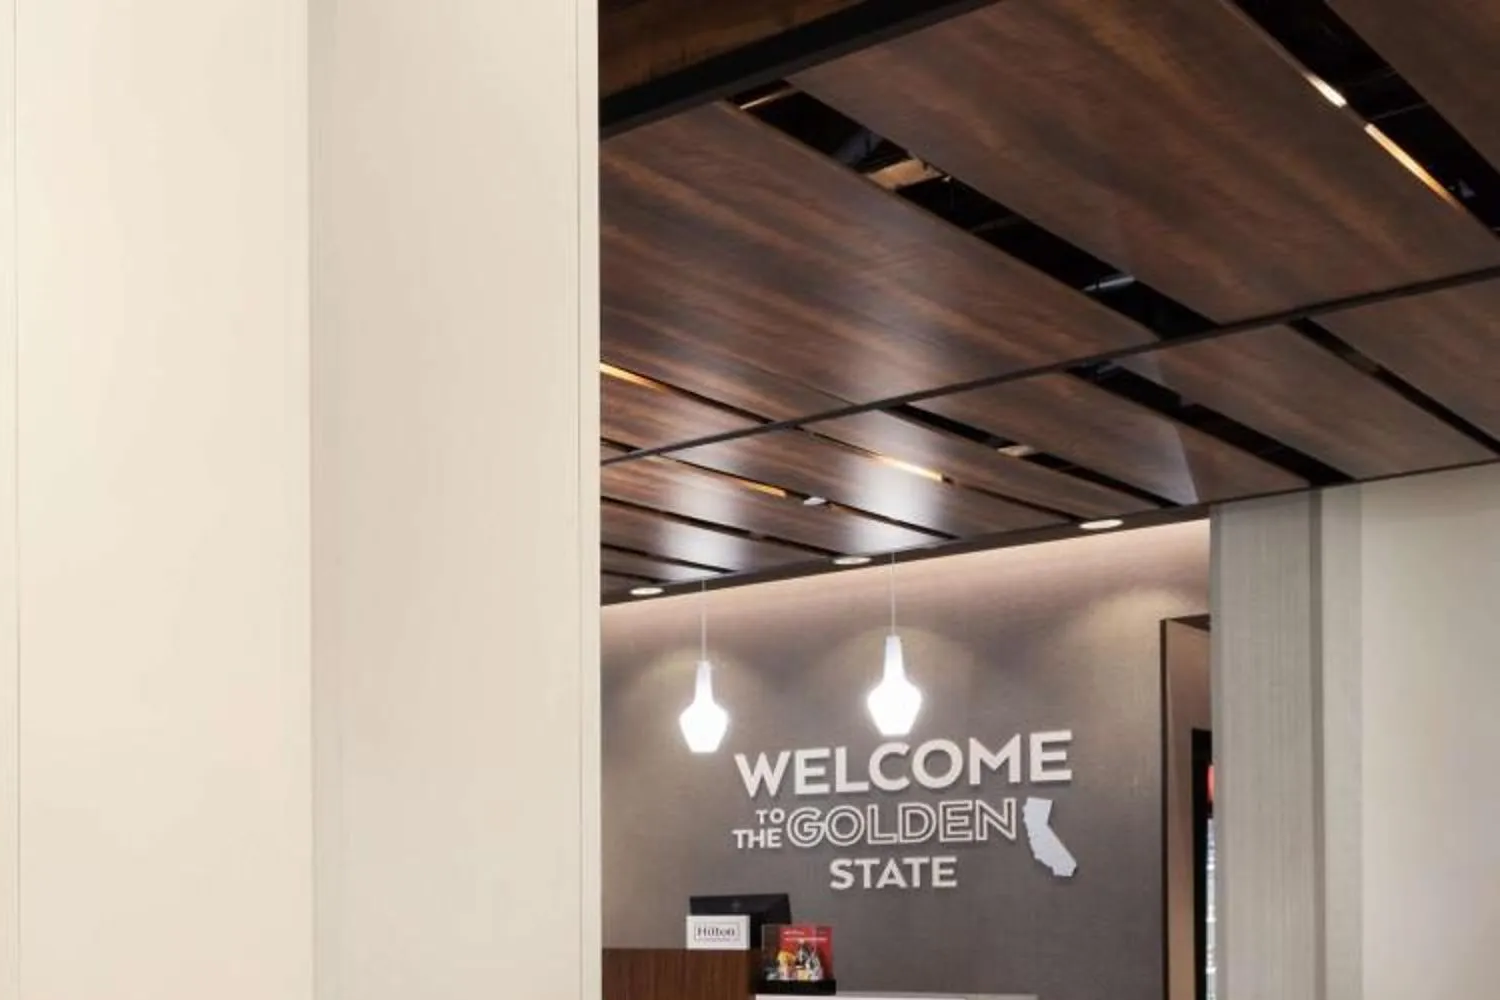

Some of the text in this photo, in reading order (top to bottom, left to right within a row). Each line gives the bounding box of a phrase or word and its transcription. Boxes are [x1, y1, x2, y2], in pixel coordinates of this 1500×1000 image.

[734, 729, 1073, 798] WELCOME
[732, 797, 1018, 849] TO THE GOLDEN
[829, 856, 957, 890] STATE
[697, 927, 735, 937] Hilton
